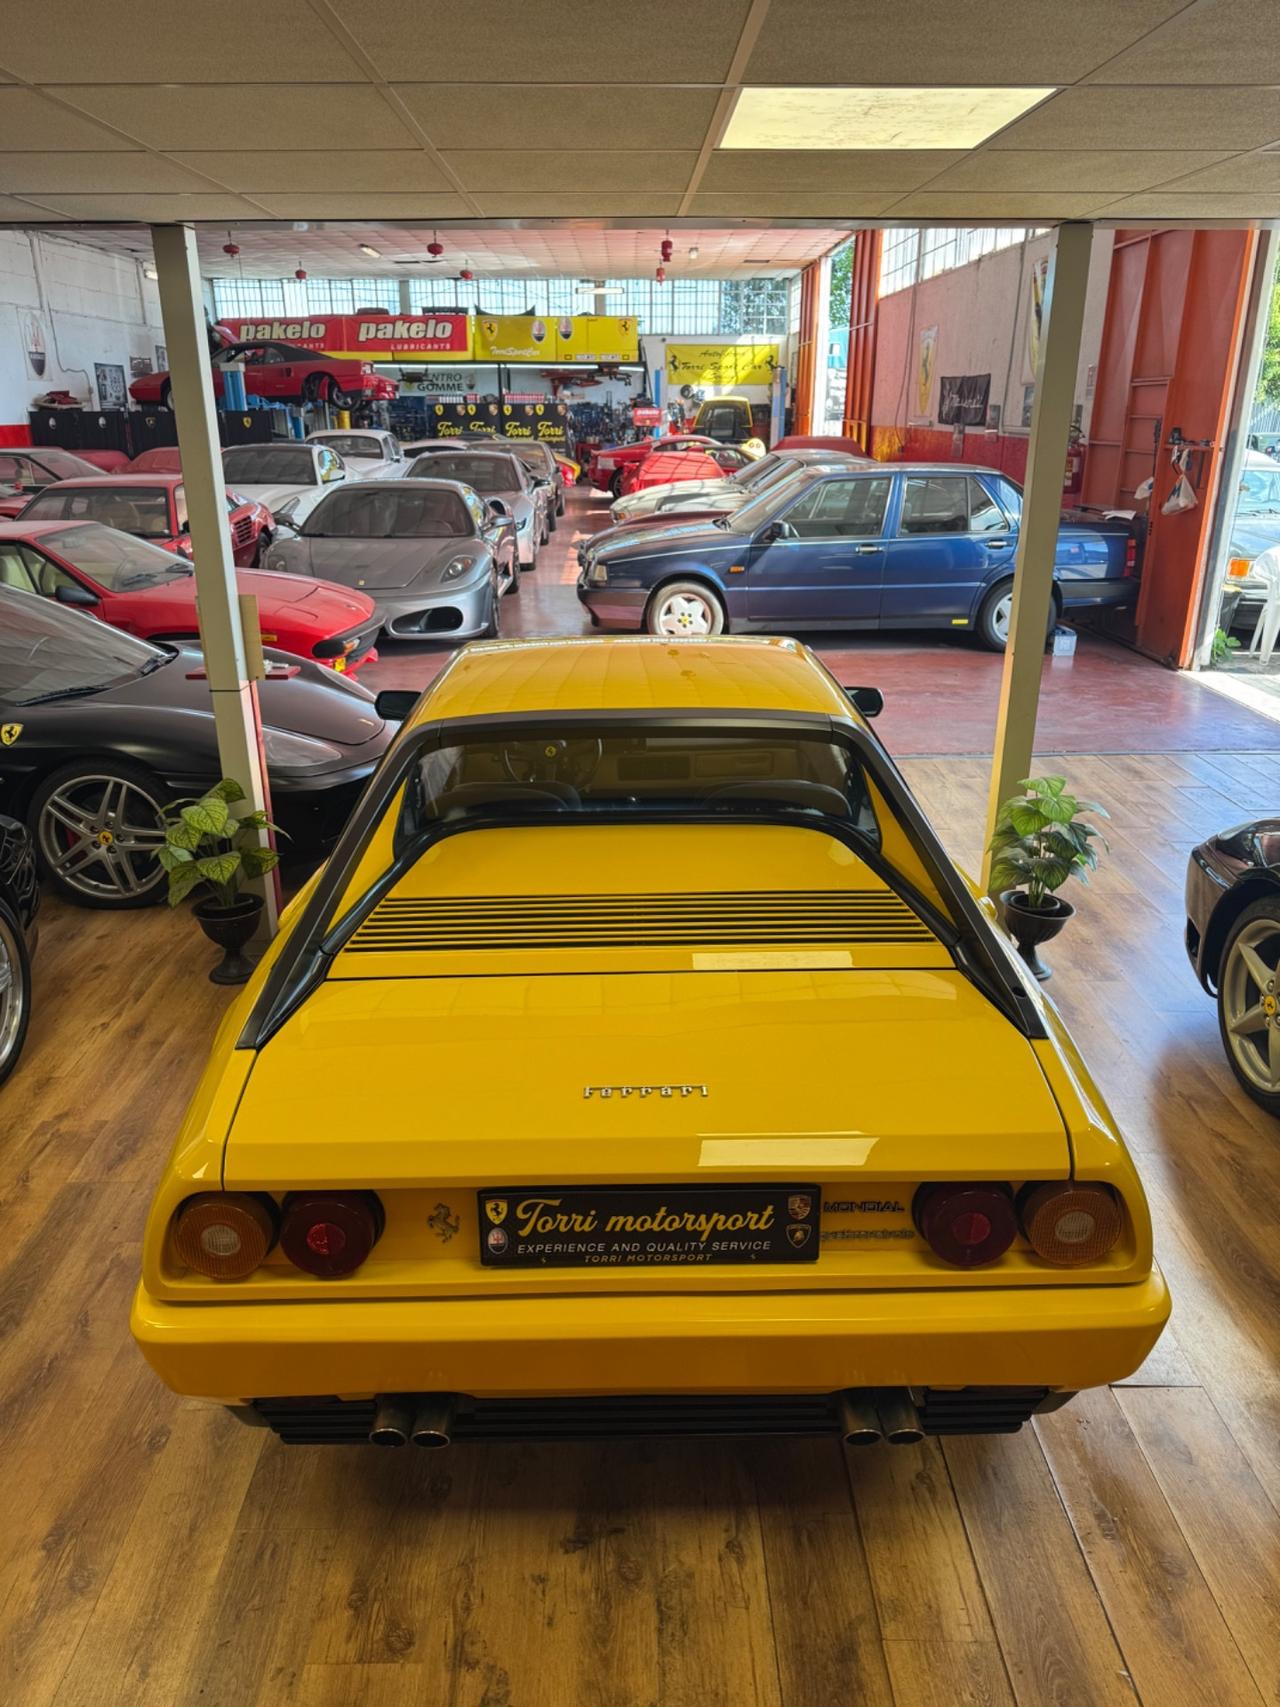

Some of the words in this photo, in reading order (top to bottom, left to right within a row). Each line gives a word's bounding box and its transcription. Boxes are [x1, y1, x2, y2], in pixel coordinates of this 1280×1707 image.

[239, 321, 326, 341] pakelo
[358, 319, 453, 341] pakelo
[431, 372, 462, 382] NTRO
[416, 383, 465, 391] GOMME
[437, 421, 463, 436] Torri
[505, 421, 532, 437] Torri
[537, 421, 564, 437] Torri
[583, 1085, 709, 1098] Ferrari
[823, 1201, 905, 1212] MONDIAL
[516, 1199, 598, 1237] Torri
[605, 1205, 776, 1242] motorsport
[517, 1242, 606, 1255] EXPERIENCE
[611, 1243, 641, 1253] AND
[646, 1242, 706, 1253] QUALITY
[711, 1240, 773, 1252] SERVICE
[584, 1255, 623, 1264] TORRI
[627, 1253, 714, 1263] MOTORSPORT
